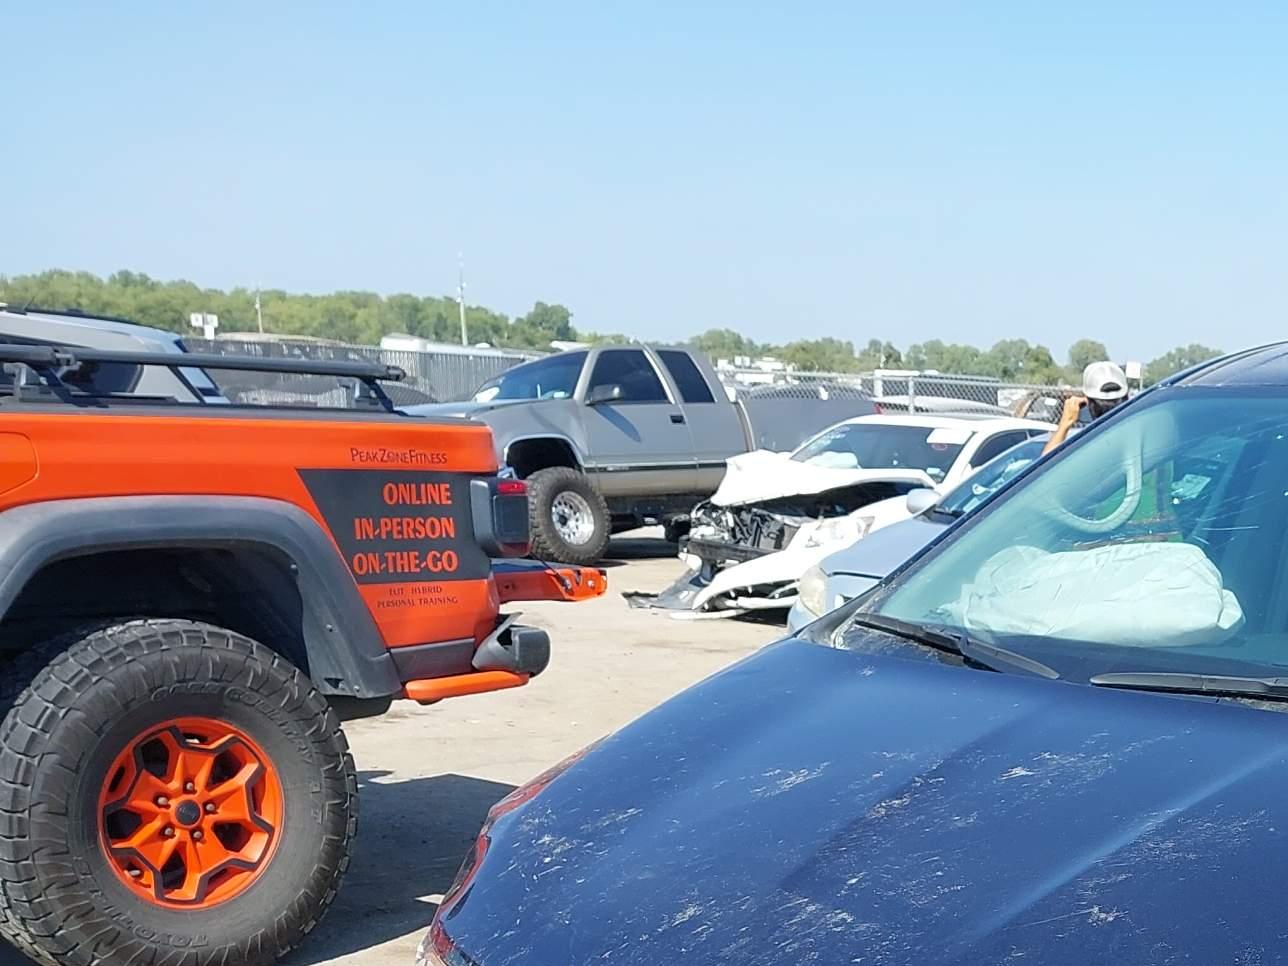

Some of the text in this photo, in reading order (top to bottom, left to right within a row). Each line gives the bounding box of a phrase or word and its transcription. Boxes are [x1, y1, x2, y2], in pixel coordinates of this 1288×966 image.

[383, 482, 452, 505] ONLINE
[354, 517, 455, 540] IN-PERSON
[352, 550, 458, 575] ON-THE-GO
[418, 597, 458, 605] TRAINING
